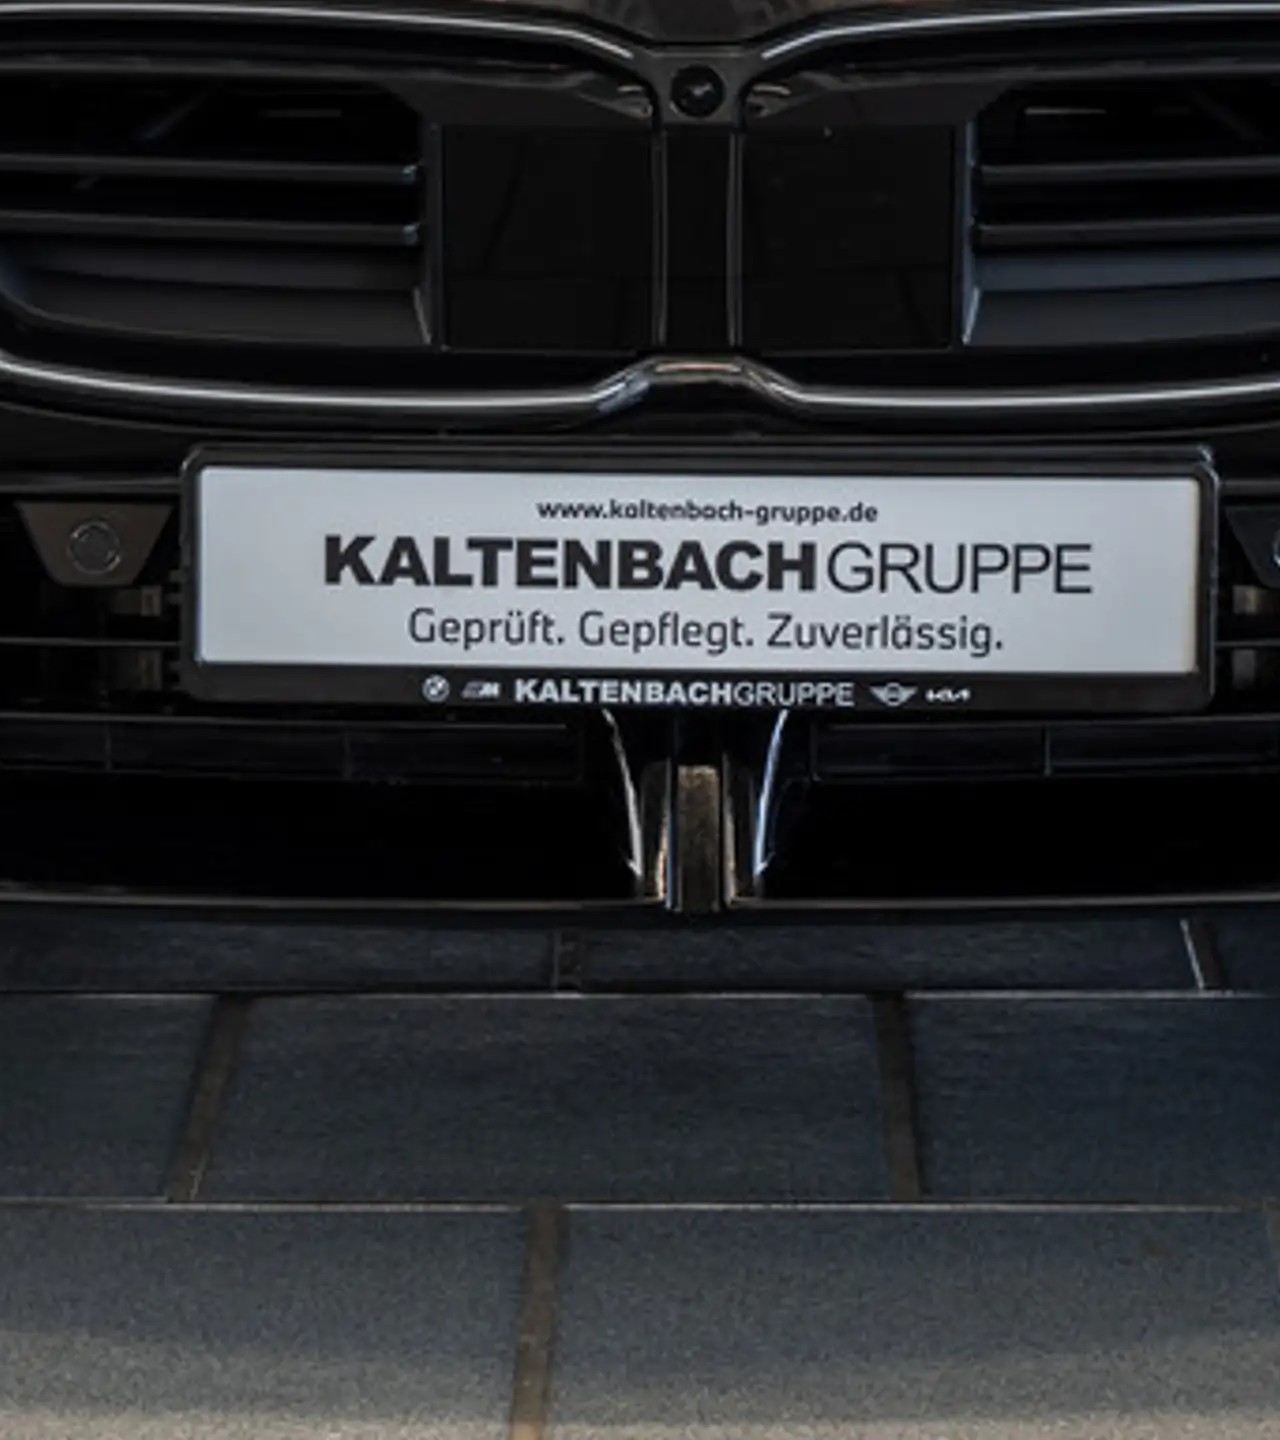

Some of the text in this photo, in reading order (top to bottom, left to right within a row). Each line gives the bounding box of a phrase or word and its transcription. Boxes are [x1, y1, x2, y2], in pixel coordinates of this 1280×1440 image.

[535, 499, 878, 525] www.kaltenbach-gruppe.de
[324, 535, 1093, 595] KALTENBACHGRUPPE
[407, 606, 1004, 658] Geprüft. Gepflegt. Zuverlässig.
[514, 678, 855, 707] KALTENBACHGRUPPE
